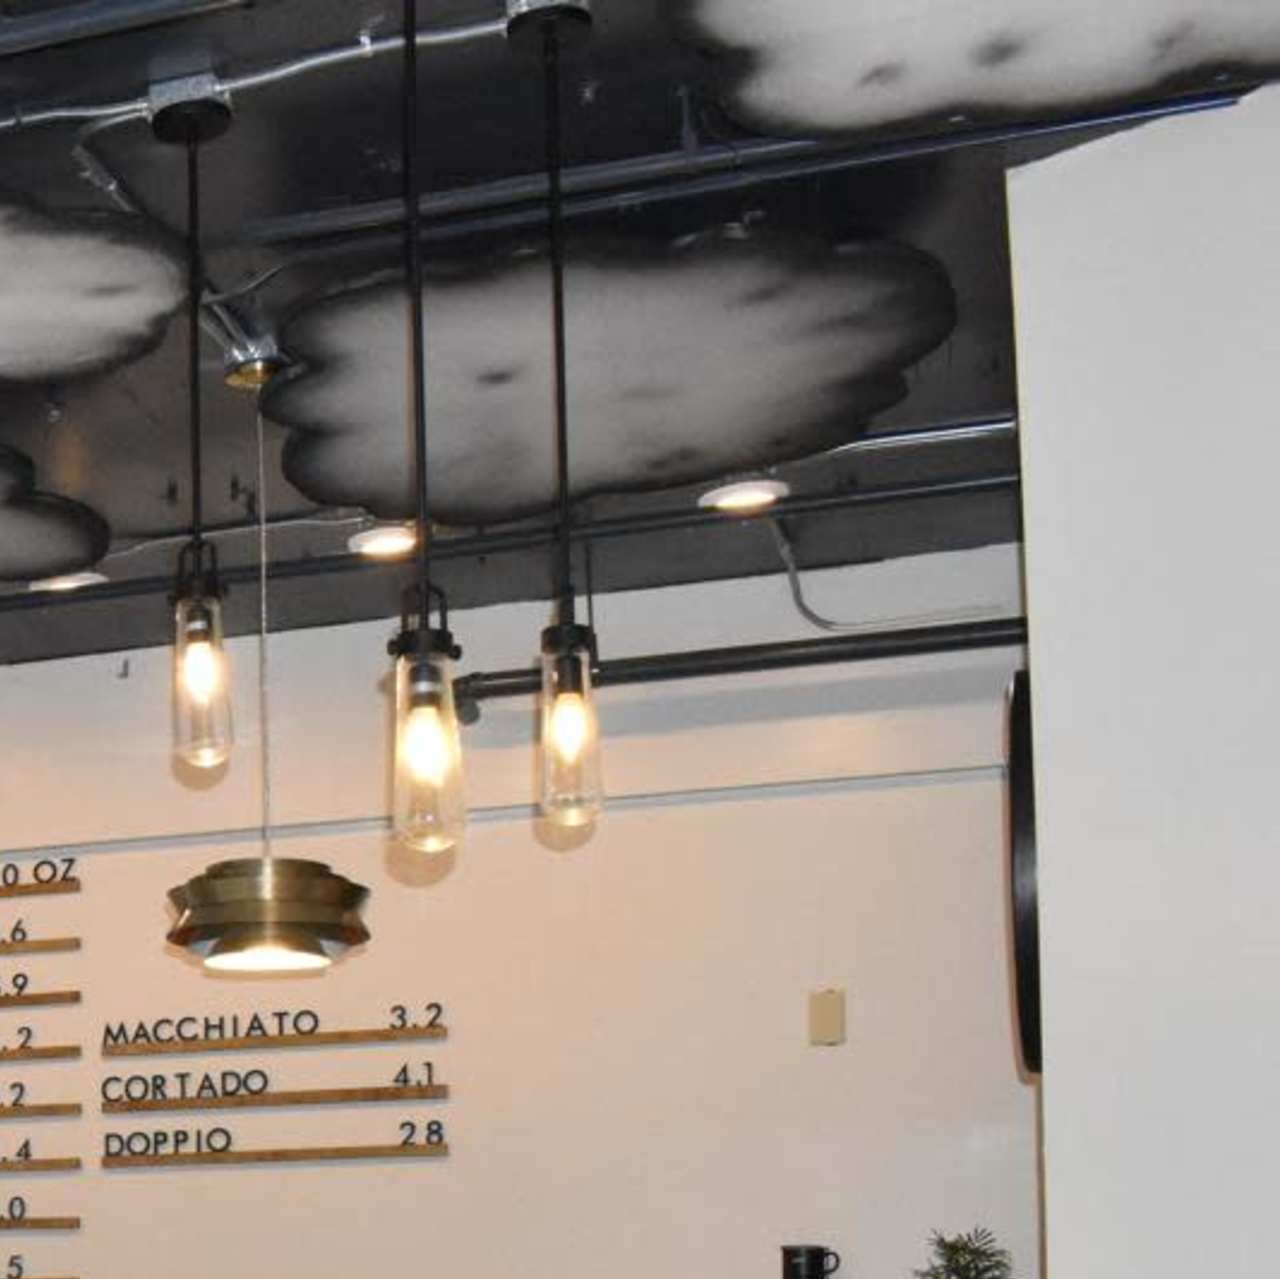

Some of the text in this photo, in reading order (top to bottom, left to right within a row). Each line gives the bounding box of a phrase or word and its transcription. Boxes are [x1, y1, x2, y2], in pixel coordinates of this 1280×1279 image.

[33, 858, 77, 883] OZ
[102, 1002, 443, 1047] MACCHIATO 3.2
[101, 1062, 435, 1102] CORTADO 4.1
[105, 1127, 231, 1157] DOPPIO
